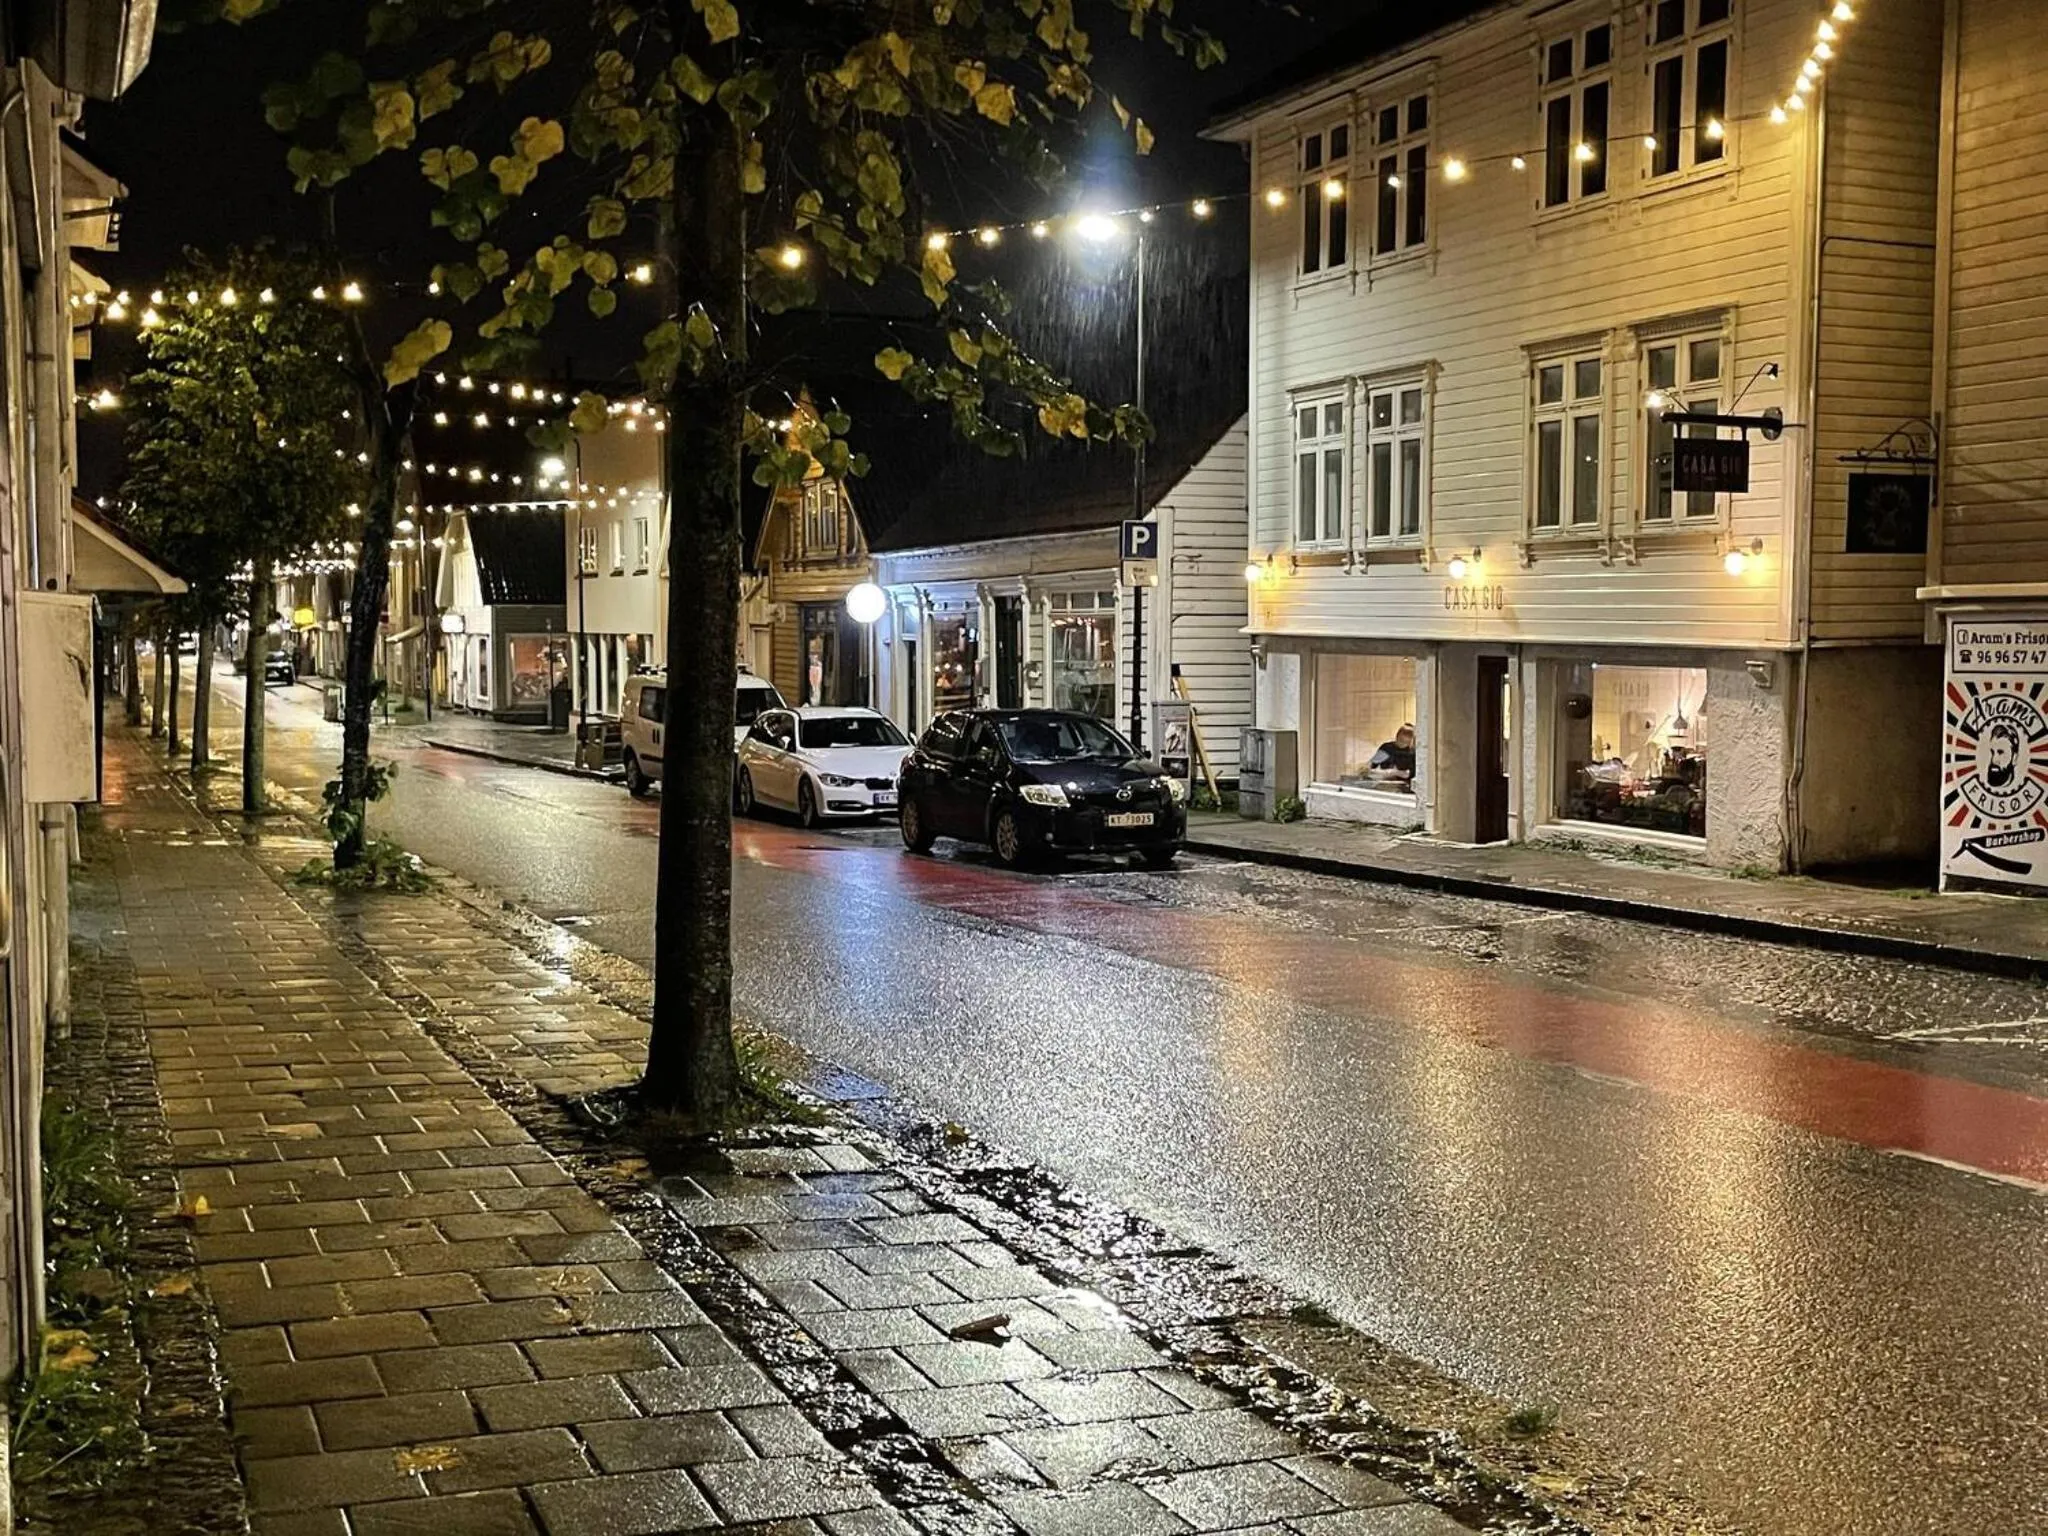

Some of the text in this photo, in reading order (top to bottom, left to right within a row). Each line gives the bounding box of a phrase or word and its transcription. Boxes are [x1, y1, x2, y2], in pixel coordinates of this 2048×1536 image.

[1682, 454, 1716, 474] CASA
[1132, 526, 1150, 554] P
[1445, 584, 1502, 610] CASA GIO
[1971, 631, 2012, 645] Aram's
[1977, 650, 2047, 664] 96 96 57 47
[1972, 697, 2036, 730] Aram's
[1968, 785, 2034, 814] FRISØR
[1986, 830, 2041, 847] Barbershop
